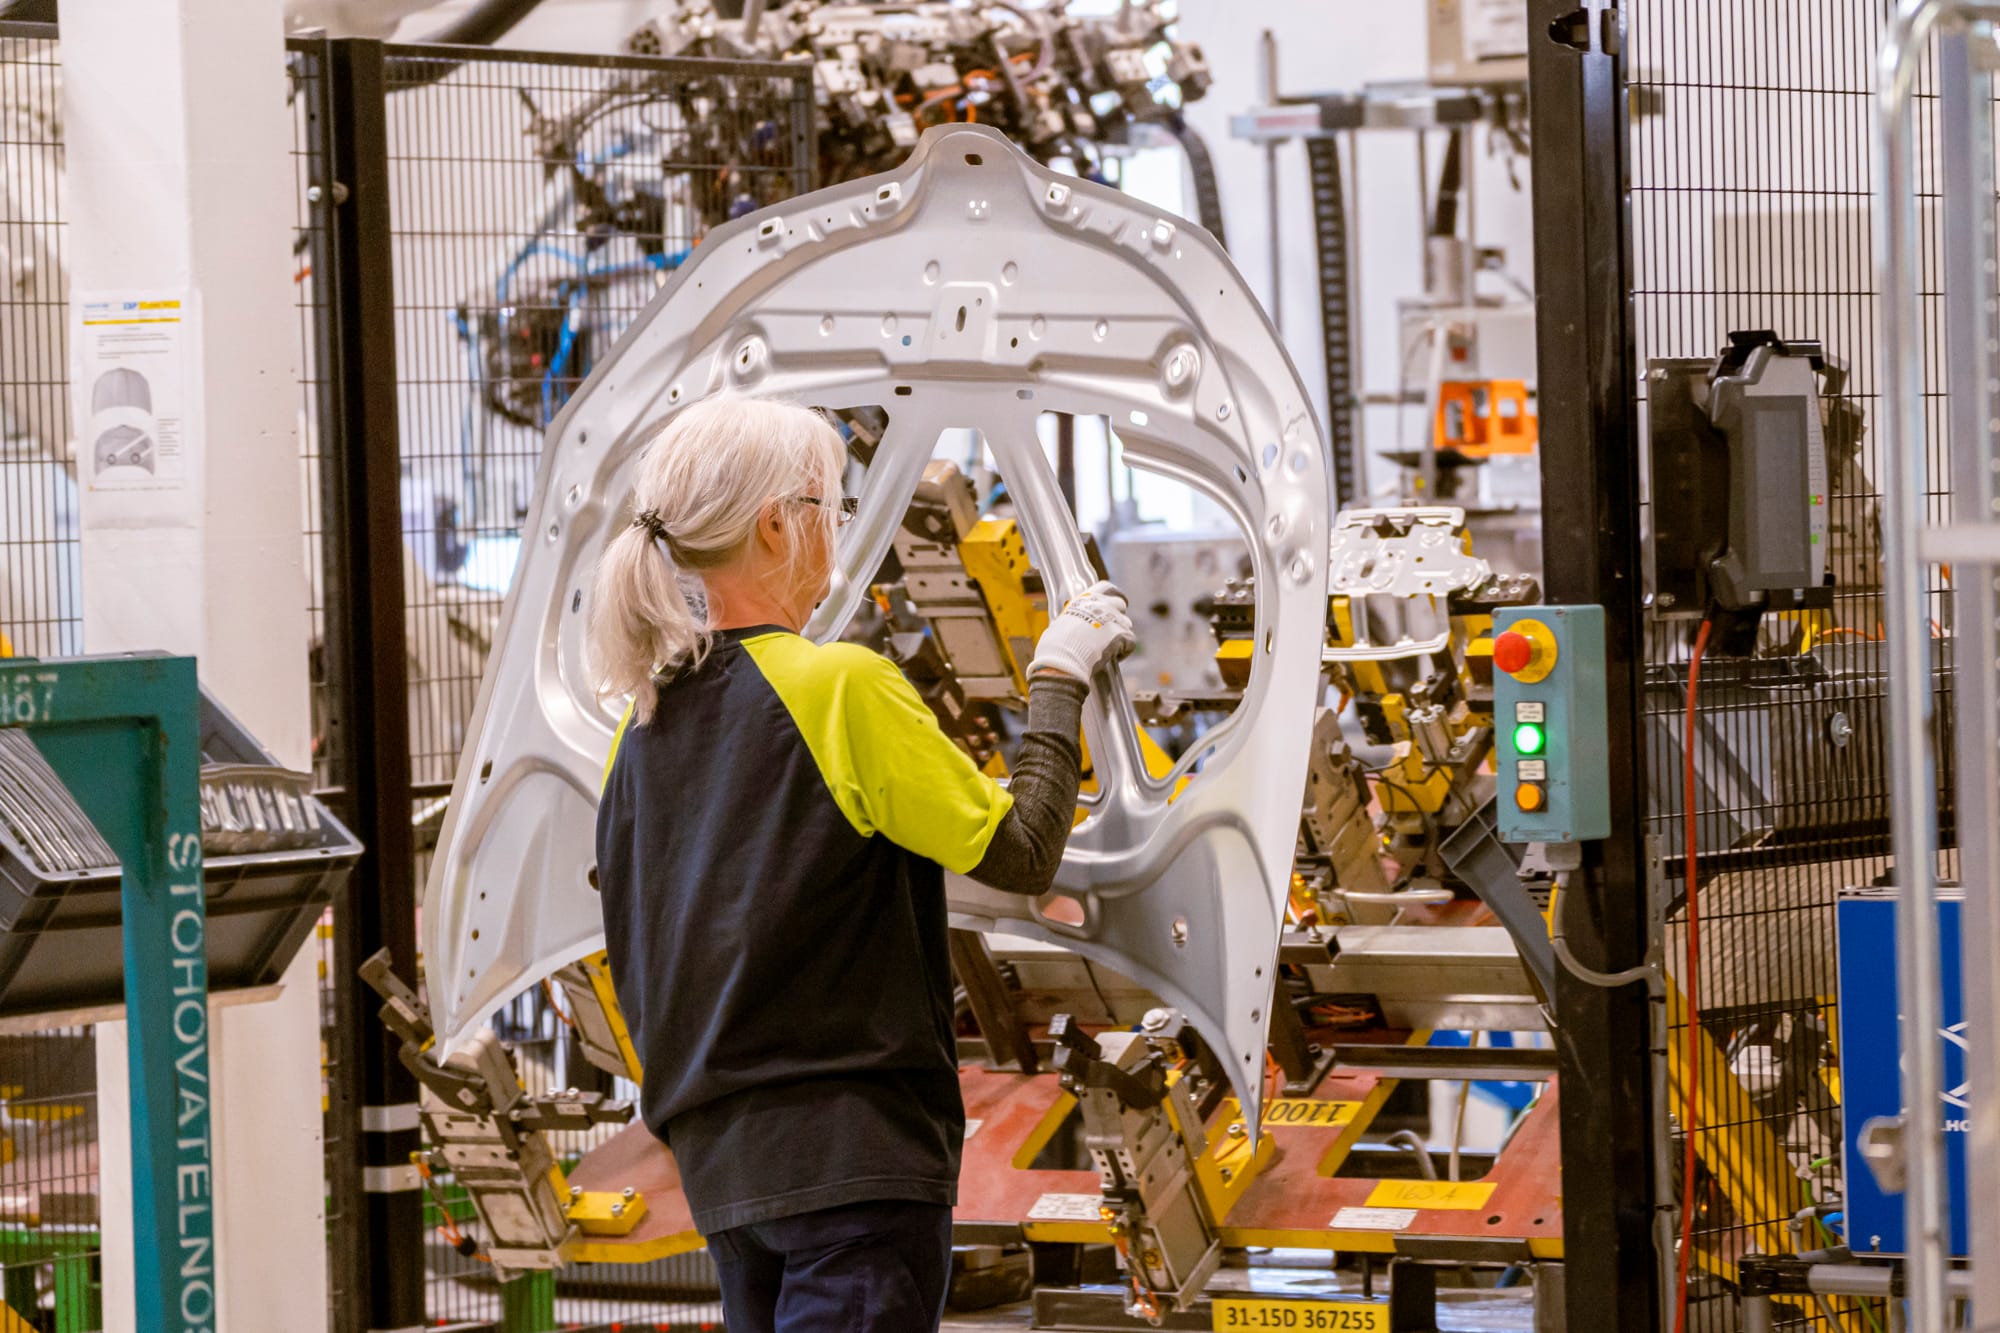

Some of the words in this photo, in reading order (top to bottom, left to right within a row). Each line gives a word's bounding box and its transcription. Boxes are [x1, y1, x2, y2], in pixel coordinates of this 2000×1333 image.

[168, 832, 215, 1333] STOHOVATELNOS
[1226, 1306, 1296, 1327] 31-15D
[1304, 1309, 1375, 1330] 367255
